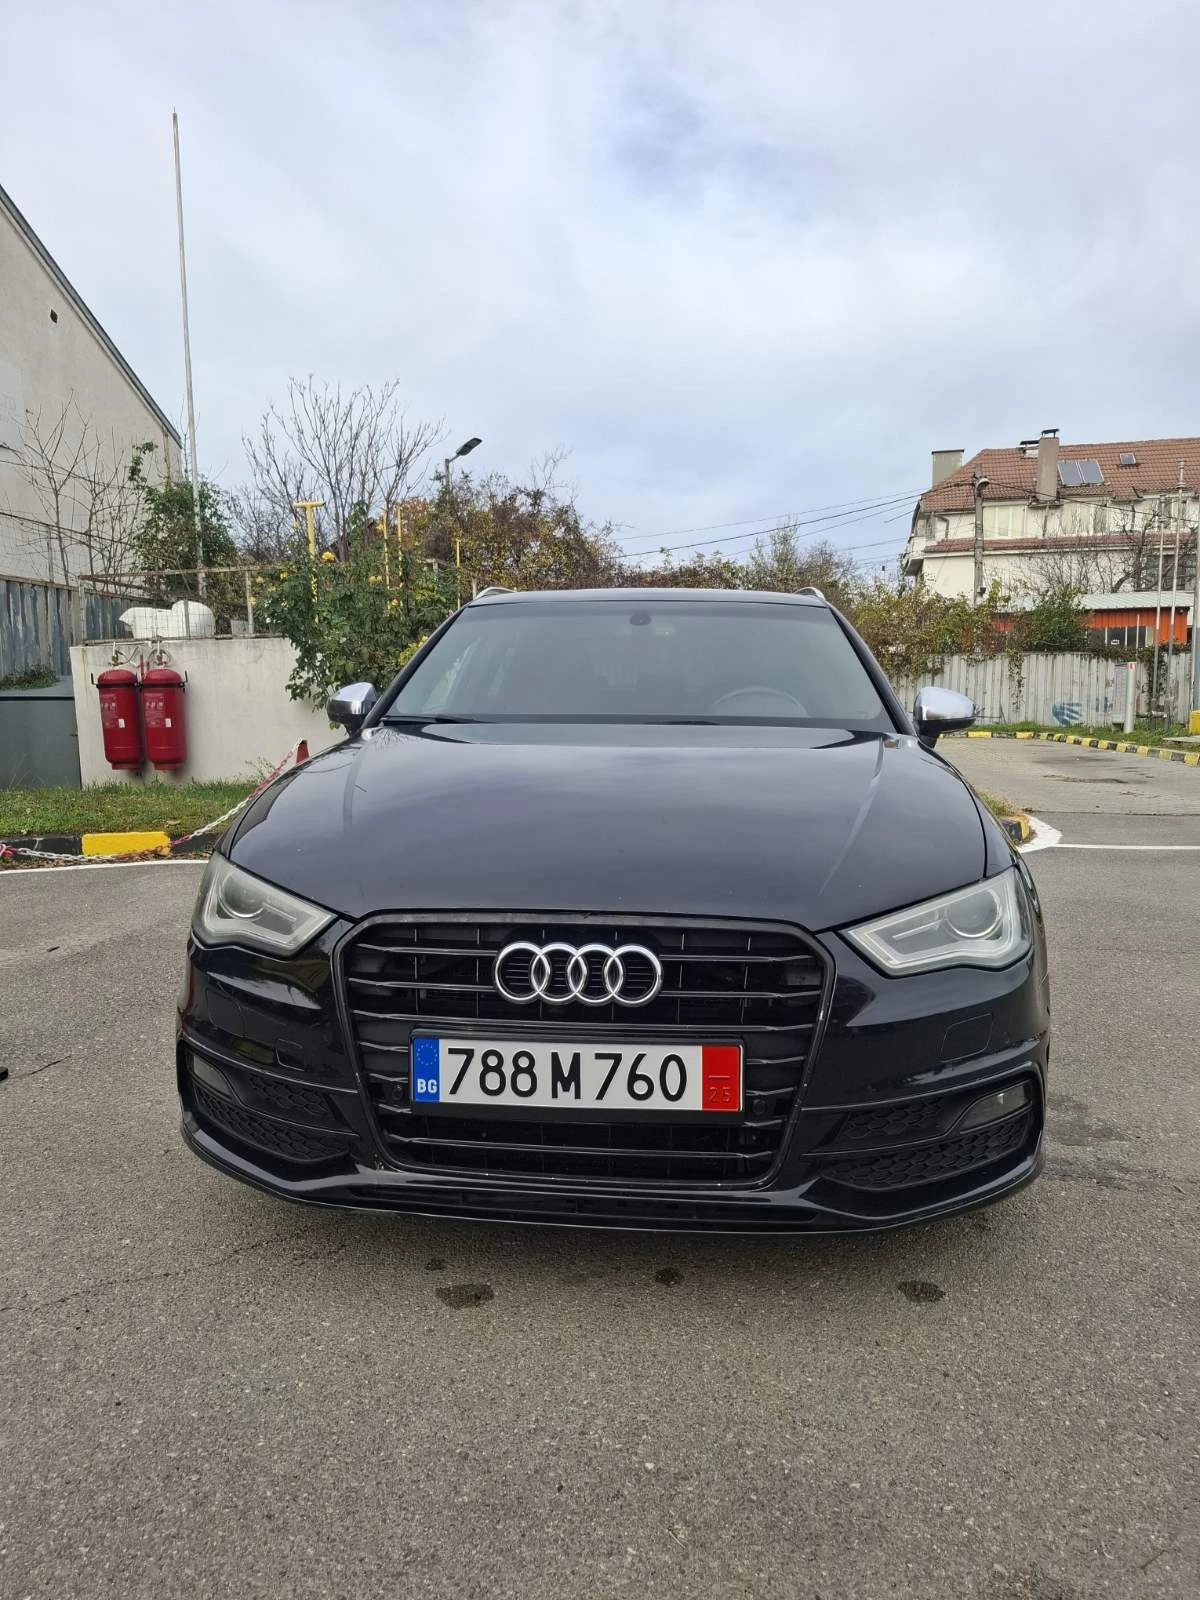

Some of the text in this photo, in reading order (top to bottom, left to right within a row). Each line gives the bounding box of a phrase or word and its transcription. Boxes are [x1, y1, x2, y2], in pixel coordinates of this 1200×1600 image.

[447, 1047, 688, 1102] 788 M 760
[417, 1078, 438, 1093] BG
[709, 1086, 731, 1103] 25
